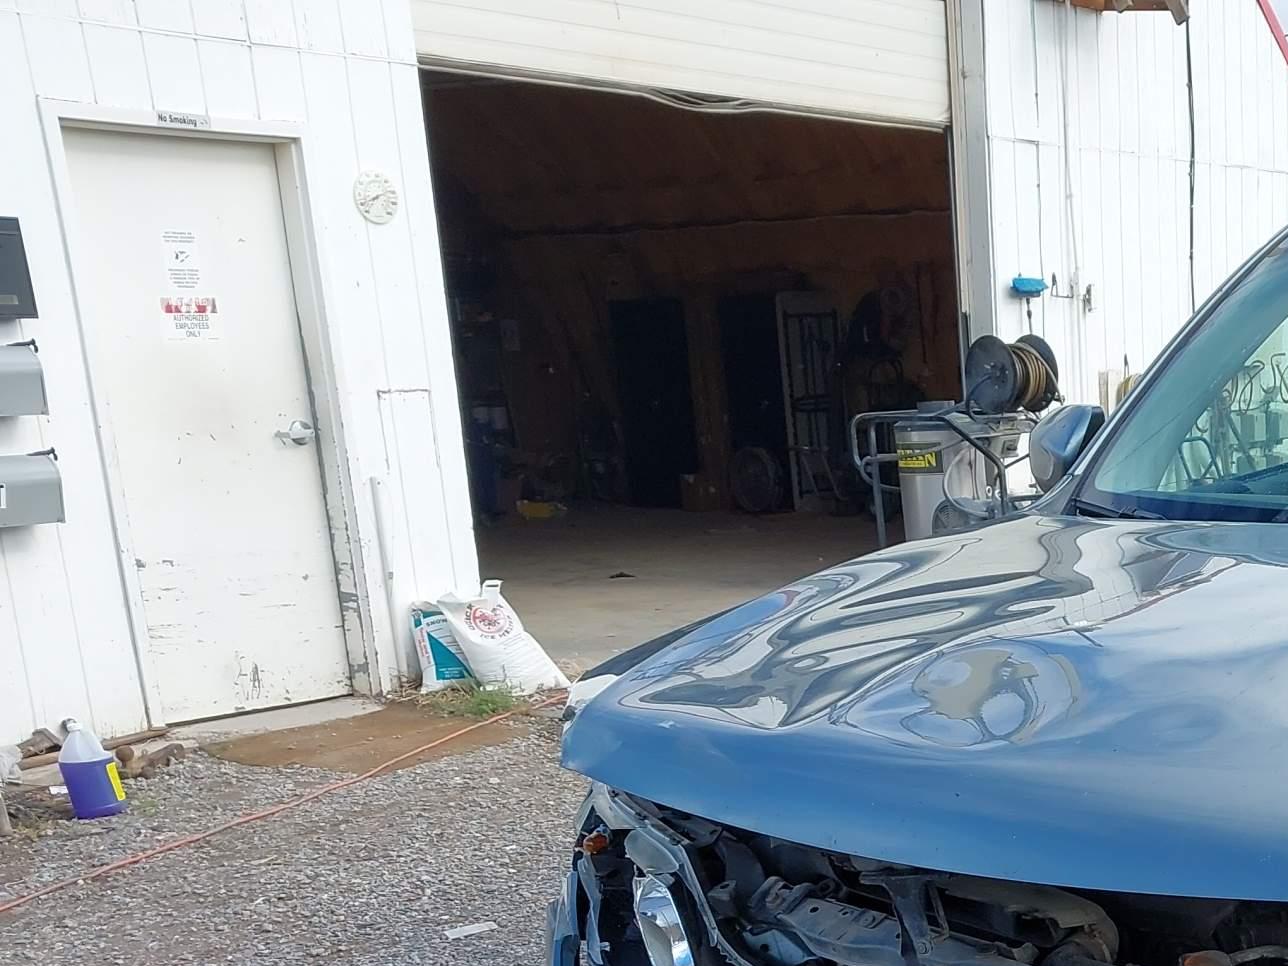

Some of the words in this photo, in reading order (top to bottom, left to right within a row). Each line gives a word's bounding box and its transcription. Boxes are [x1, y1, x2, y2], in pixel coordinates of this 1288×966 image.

[158, 113, 167, 122] No
[169, 114, 197, 128] Smoking
[173, 314, 209, 322] AUTHORIZED
[175, 322, 209, 330] EMPLOYEES
[185, 330, 201, 338] ONLY
